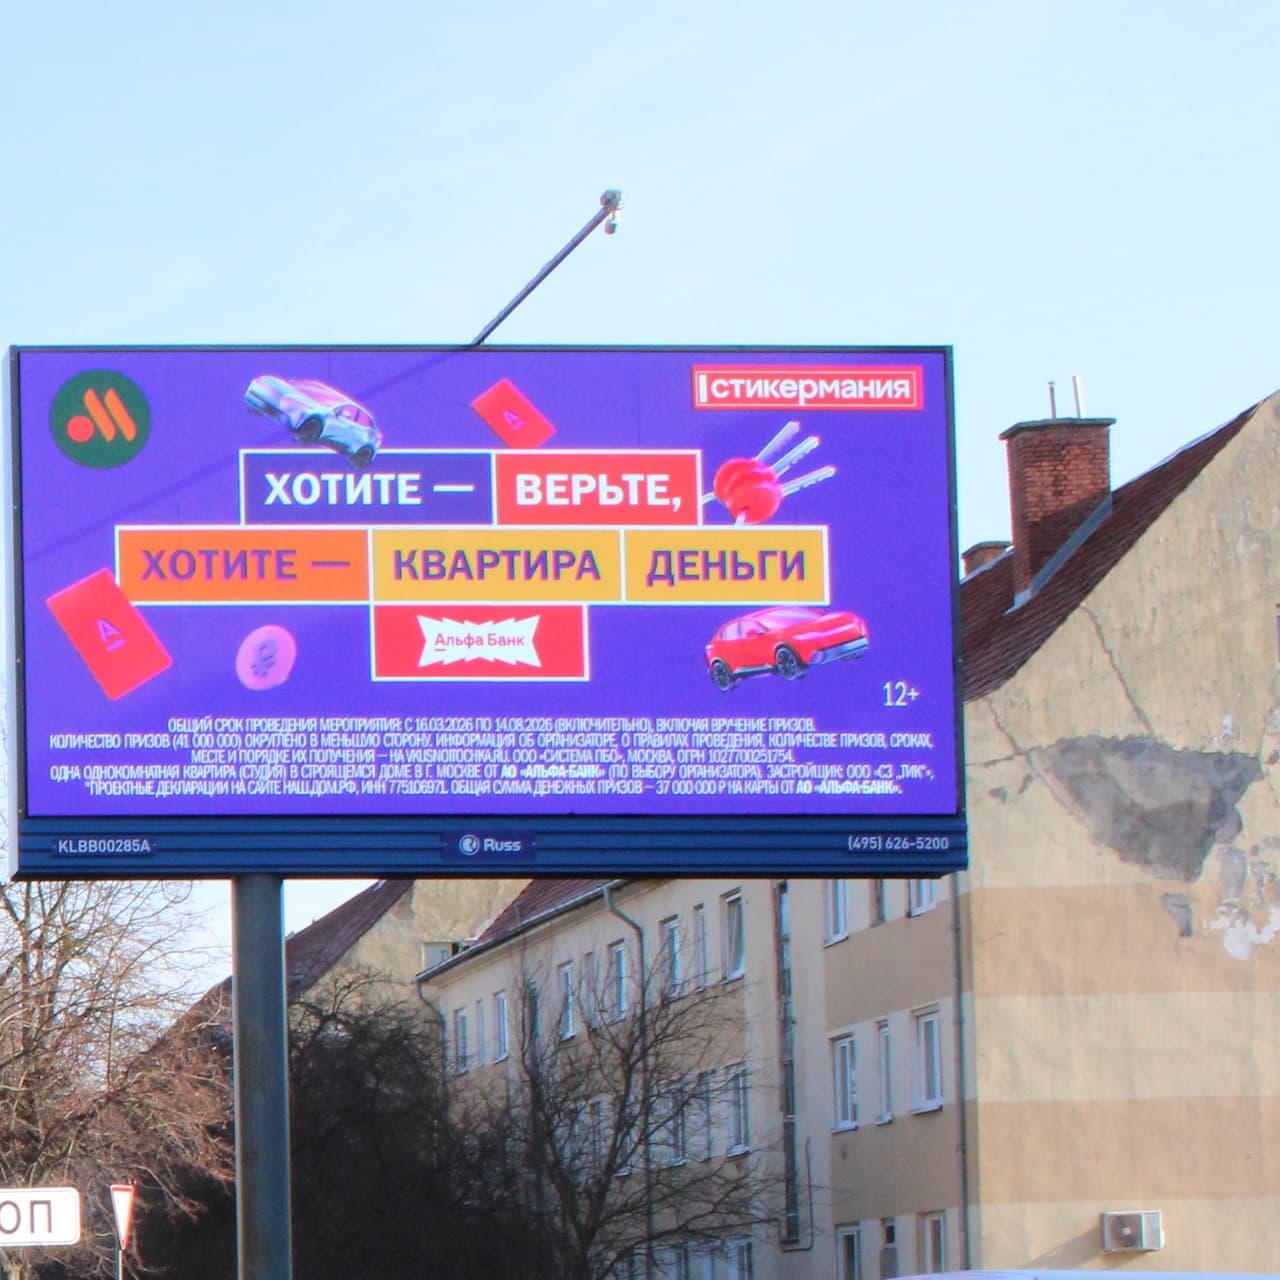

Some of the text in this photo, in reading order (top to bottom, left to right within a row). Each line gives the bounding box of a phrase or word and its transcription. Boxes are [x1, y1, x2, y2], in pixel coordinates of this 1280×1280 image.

[711, 377, 910, 404] стикермания
[264, 474, 421, 505] ХОТИТЕ
[516, 473, 682, 511] ВЕРЬТЕ,
[141, 549, 297, 581] ХОТИТЕ
[393, 550, 601, 581] КВАРТИРА
[646, 550, 806, 587] ДЕНЬГИ
[486, 633, 525, 647] Банк
[882, 680, 920, 706] 12+
[214, 718, 244, 732] СРОК
[474, 718, 492, 732] ПО
[124, 733, 170, 748] ПРИЗОВ
[58, 839, 151, 853] KLBB00285A
[483, 838, 522, 852] Russ
[847, 835, 949, 851] (495) 626-5200
